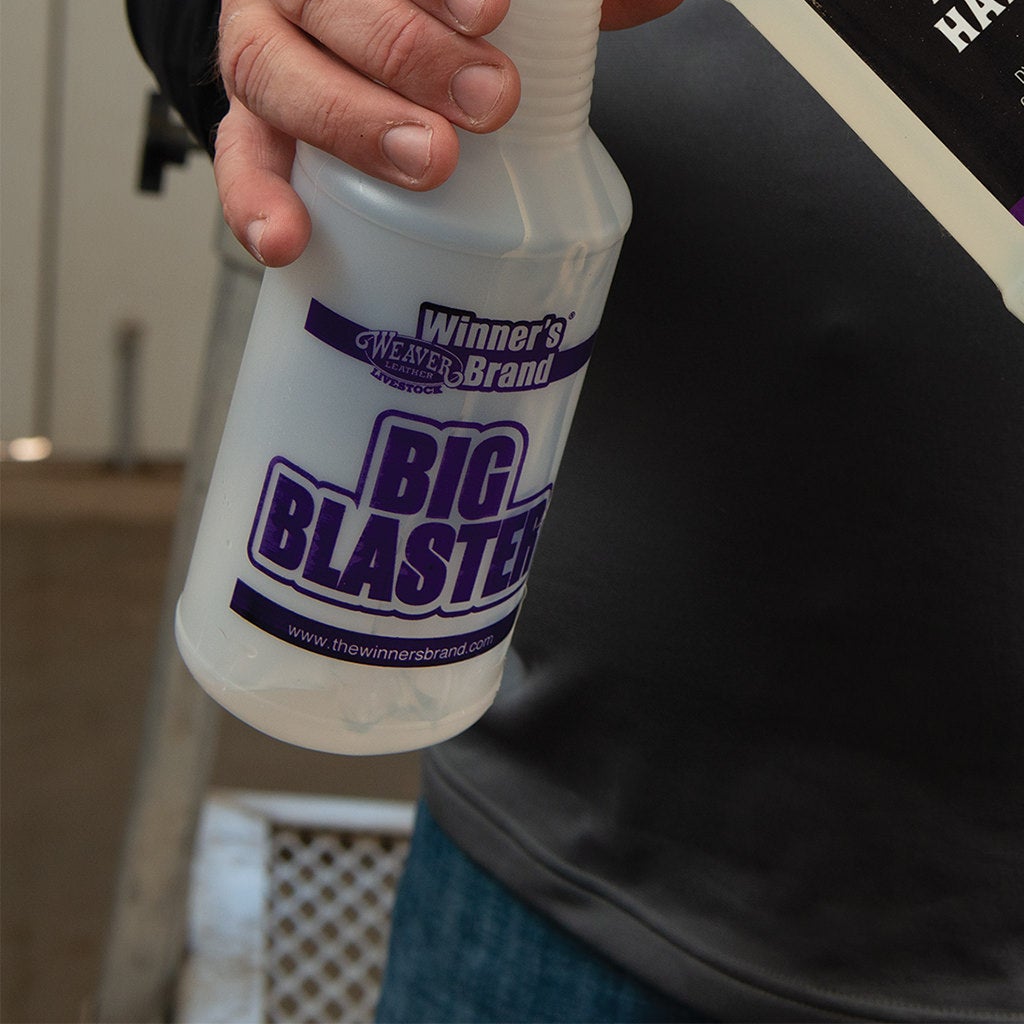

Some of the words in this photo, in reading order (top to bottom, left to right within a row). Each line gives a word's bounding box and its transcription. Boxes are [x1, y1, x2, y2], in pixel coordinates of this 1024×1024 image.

[421, 309, 565, 352] Winner's
[355, 330, 464, 388] WEAVER
[384, 361, 434, 379] LEATHER
[463, 353, 555, 388] Brand
[370, 366, 443, 394] LIVESTOCK
[369, 424, 516, 520] BIG
[287, 624, 494, 662] www.thewinnersbrand.com
